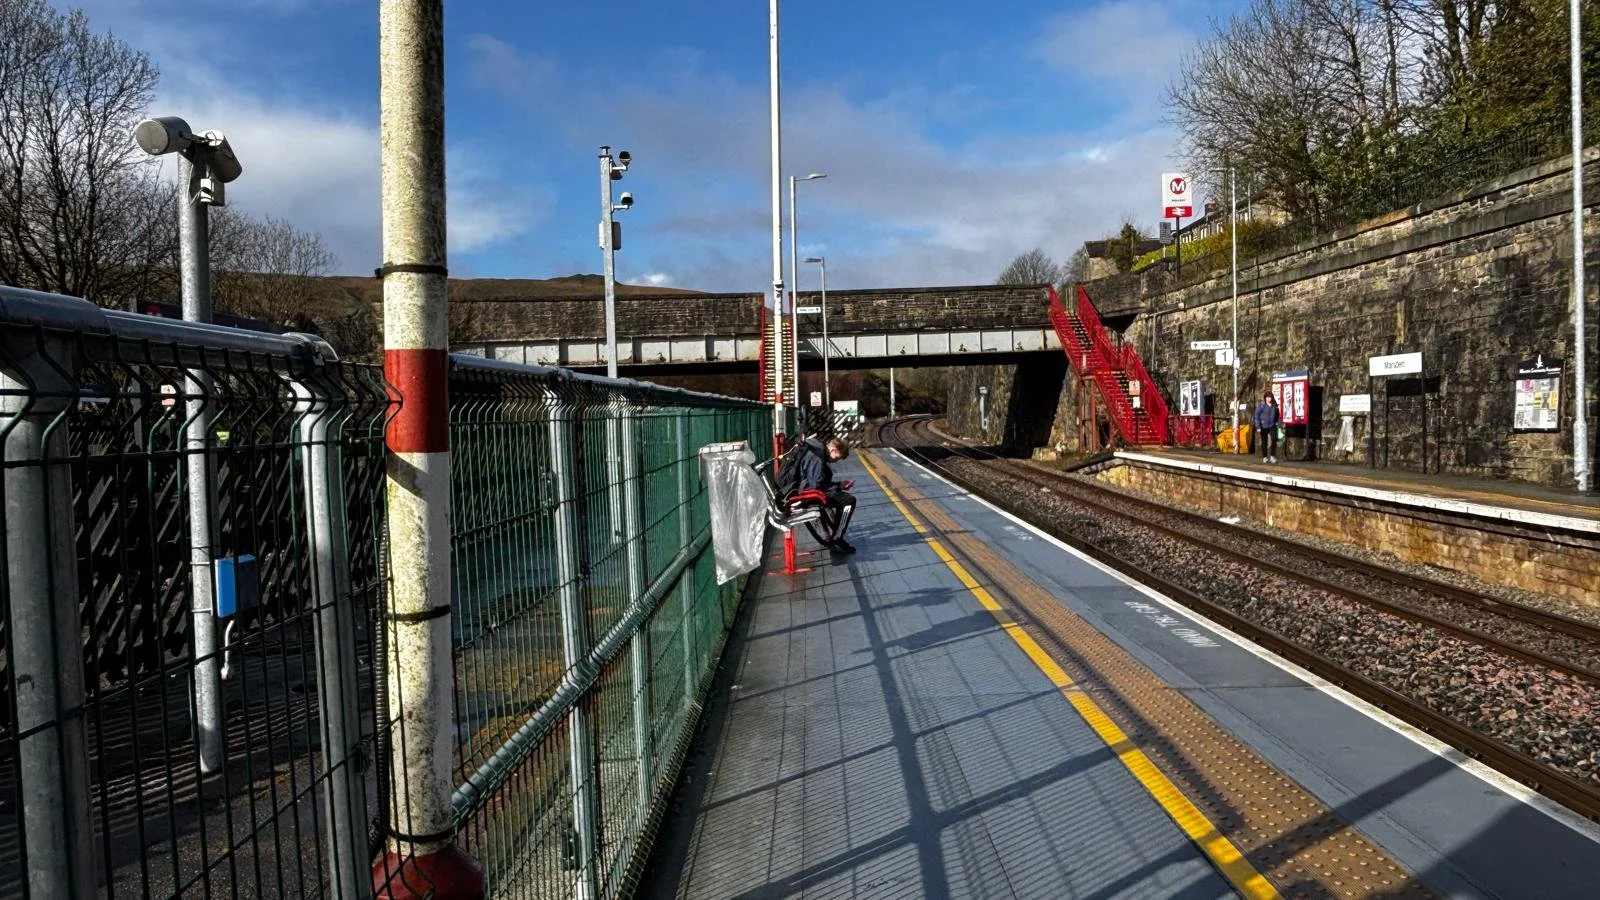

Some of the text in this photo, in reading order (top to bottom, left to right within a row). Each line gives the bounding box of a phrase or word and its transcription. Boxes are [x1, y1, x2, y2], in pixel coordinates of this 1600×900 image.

[1171, 180, 1185, 192] M
[1221, 351, 1227, 362] 1
[1383, 361, 1405, 369] Marsden
